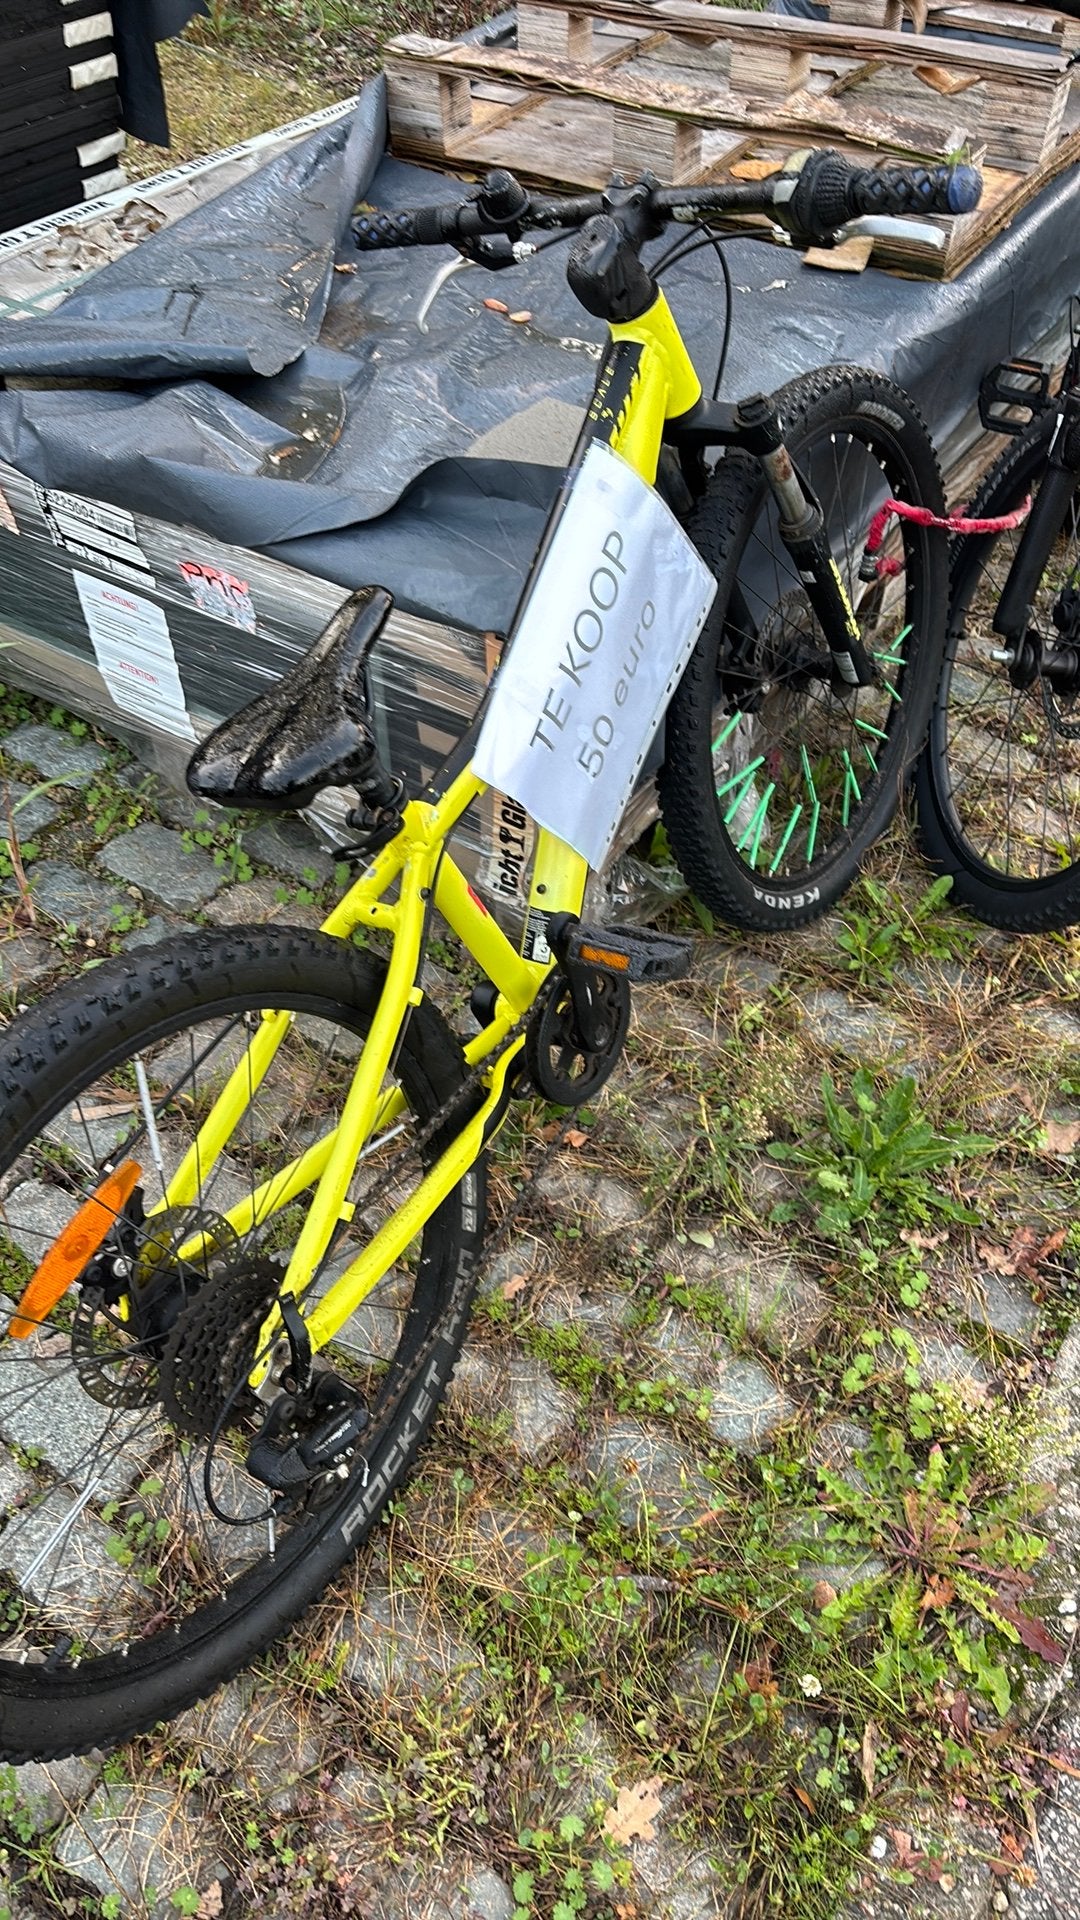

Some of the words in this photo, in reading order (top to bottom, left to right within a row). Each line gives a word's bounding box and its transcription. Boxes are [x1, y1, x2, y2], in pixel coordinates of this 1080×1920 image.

[588, 366, 615, 421] SCALE
[529, 687, 572, 752] TE
[558, 530, 627, 688] KOOP
[578, 714, 615, 779] 50
[614, 600, 656, 707] euro
[752, 886, 820, 910] KENDA
[341, 1359, 441, 1546] ROCKET
